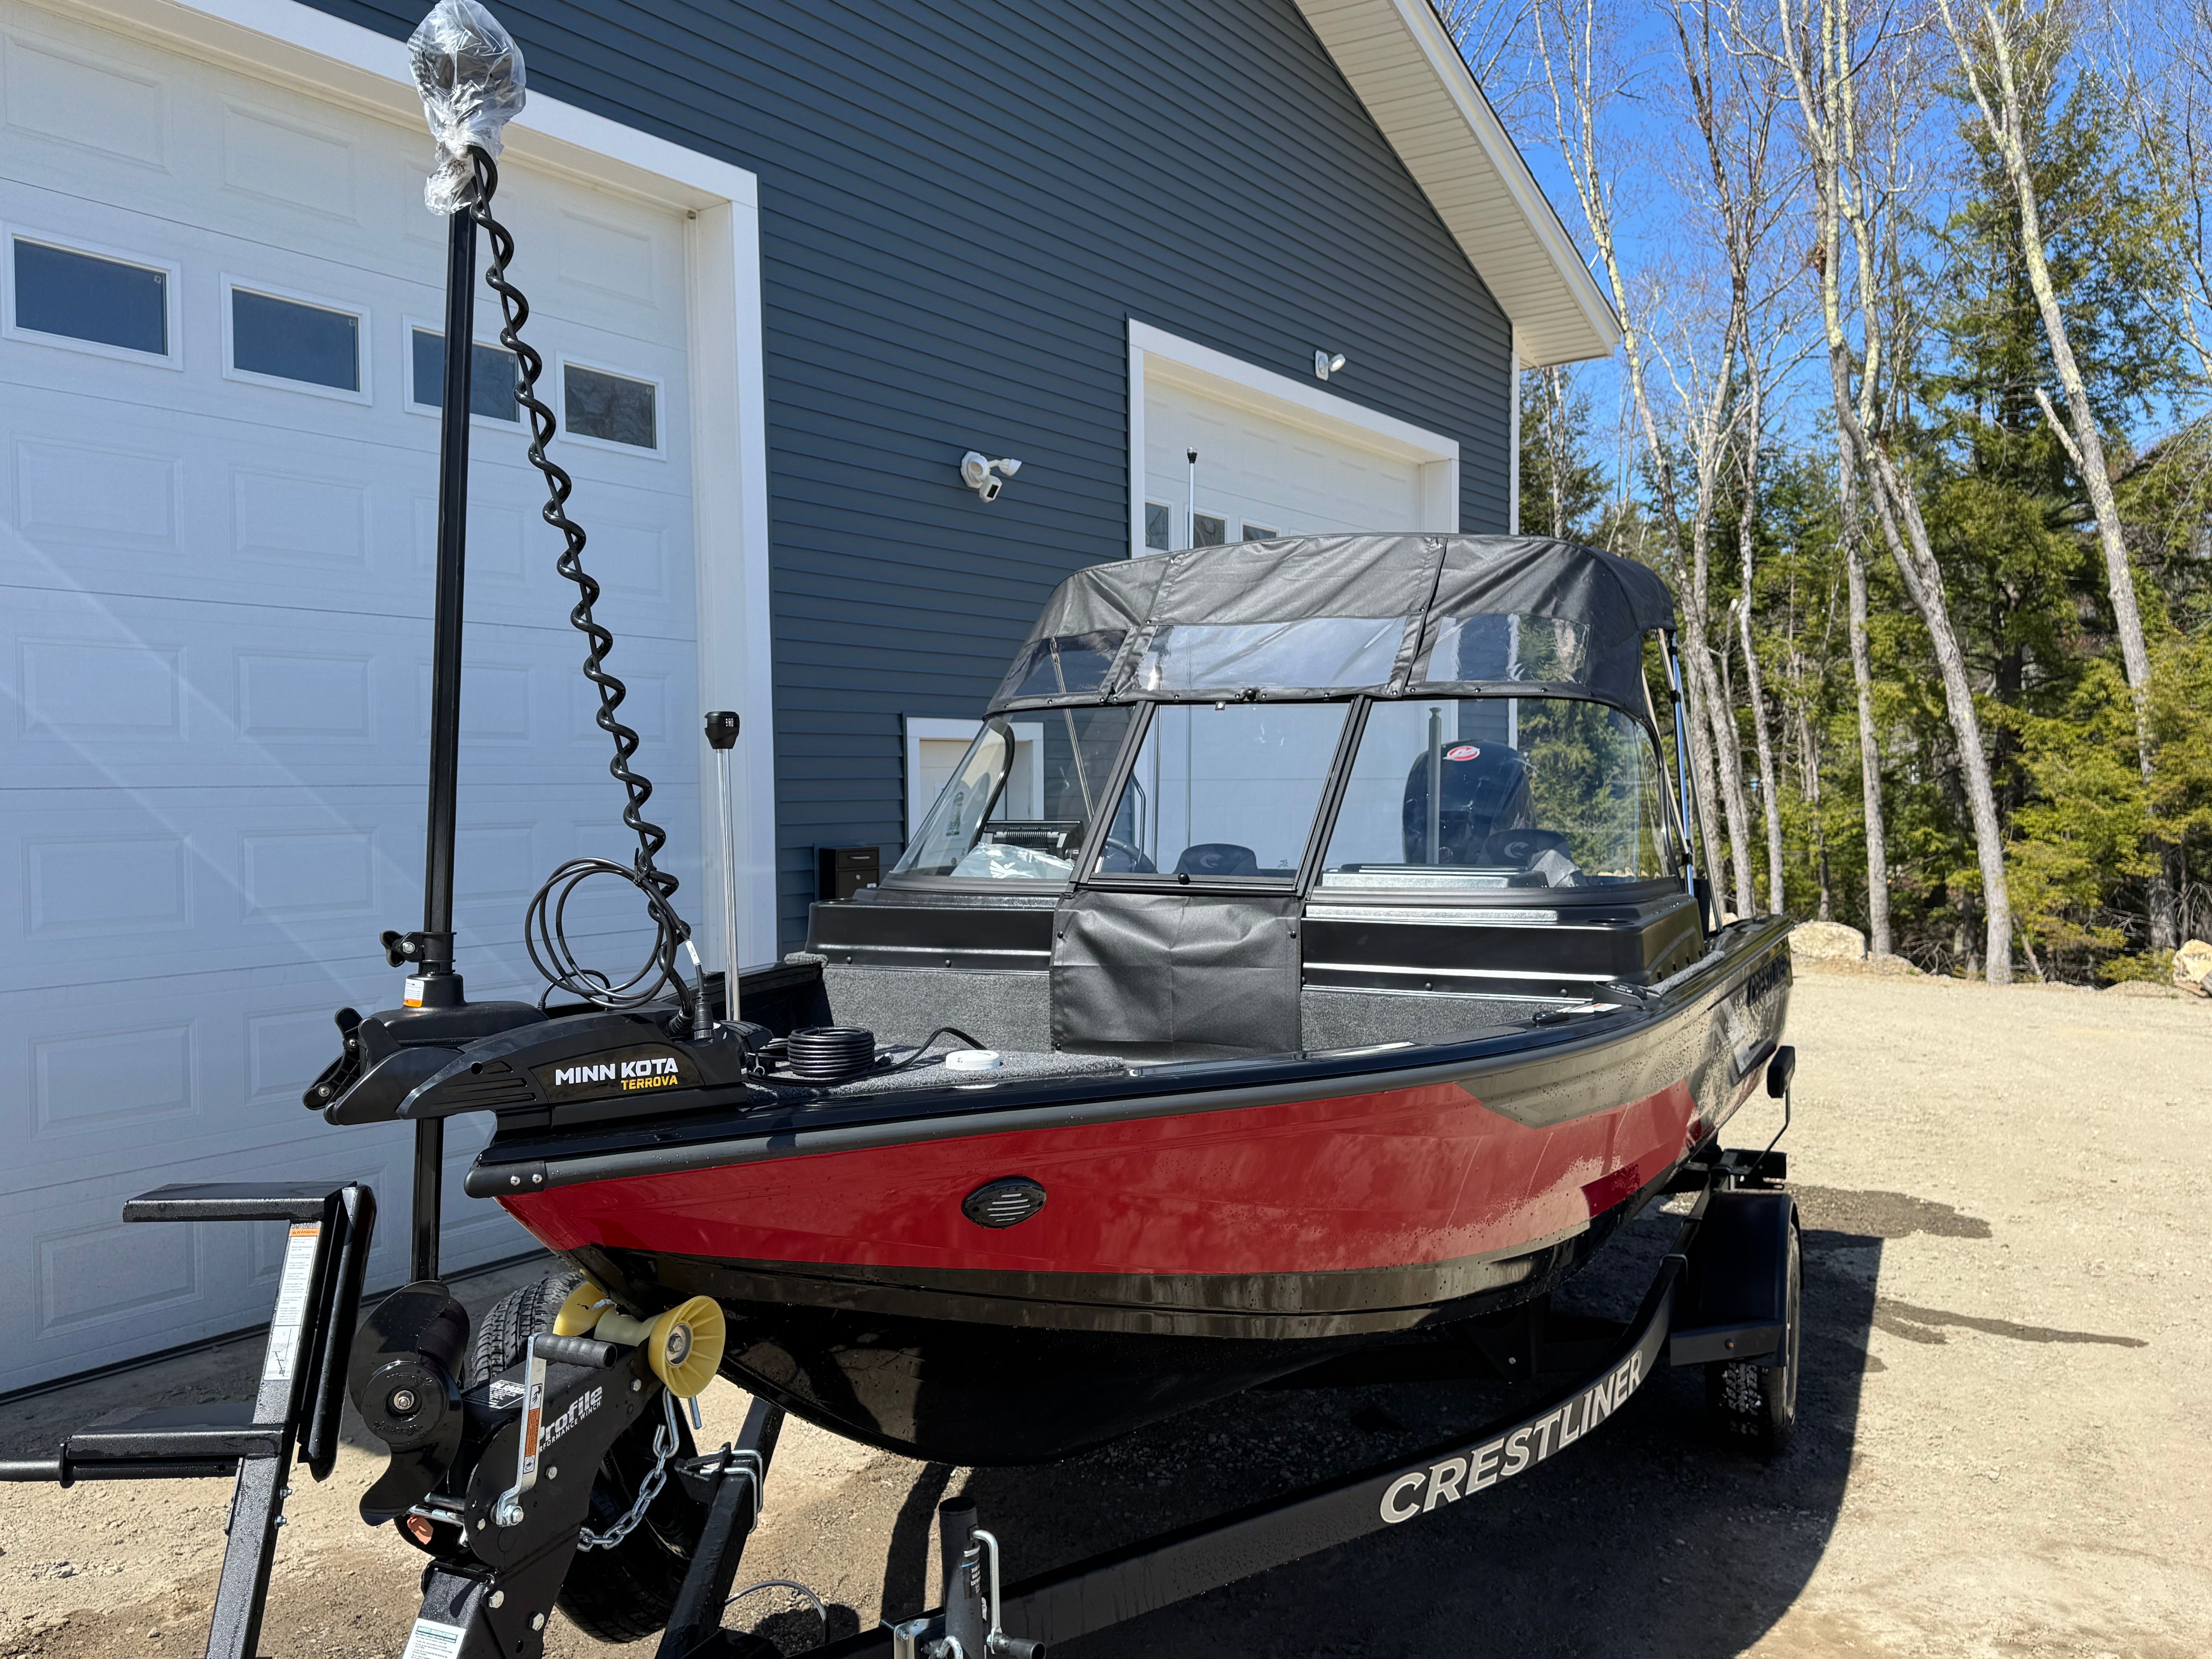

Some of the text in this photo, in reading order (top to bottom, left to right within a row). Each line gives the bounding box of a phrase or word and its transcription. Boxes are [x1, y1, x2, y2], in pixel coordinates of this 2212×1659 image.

[555, 1058, 679, 1085] MINN KOTA
[620, 1075, 678, 1091] TERROVA
[539, 1418, 578, 1453] RFORMANCE
[580, 1400, 601, 1420] WINCH
[1379, 1349, 1643, 1524] CRESTLINER
